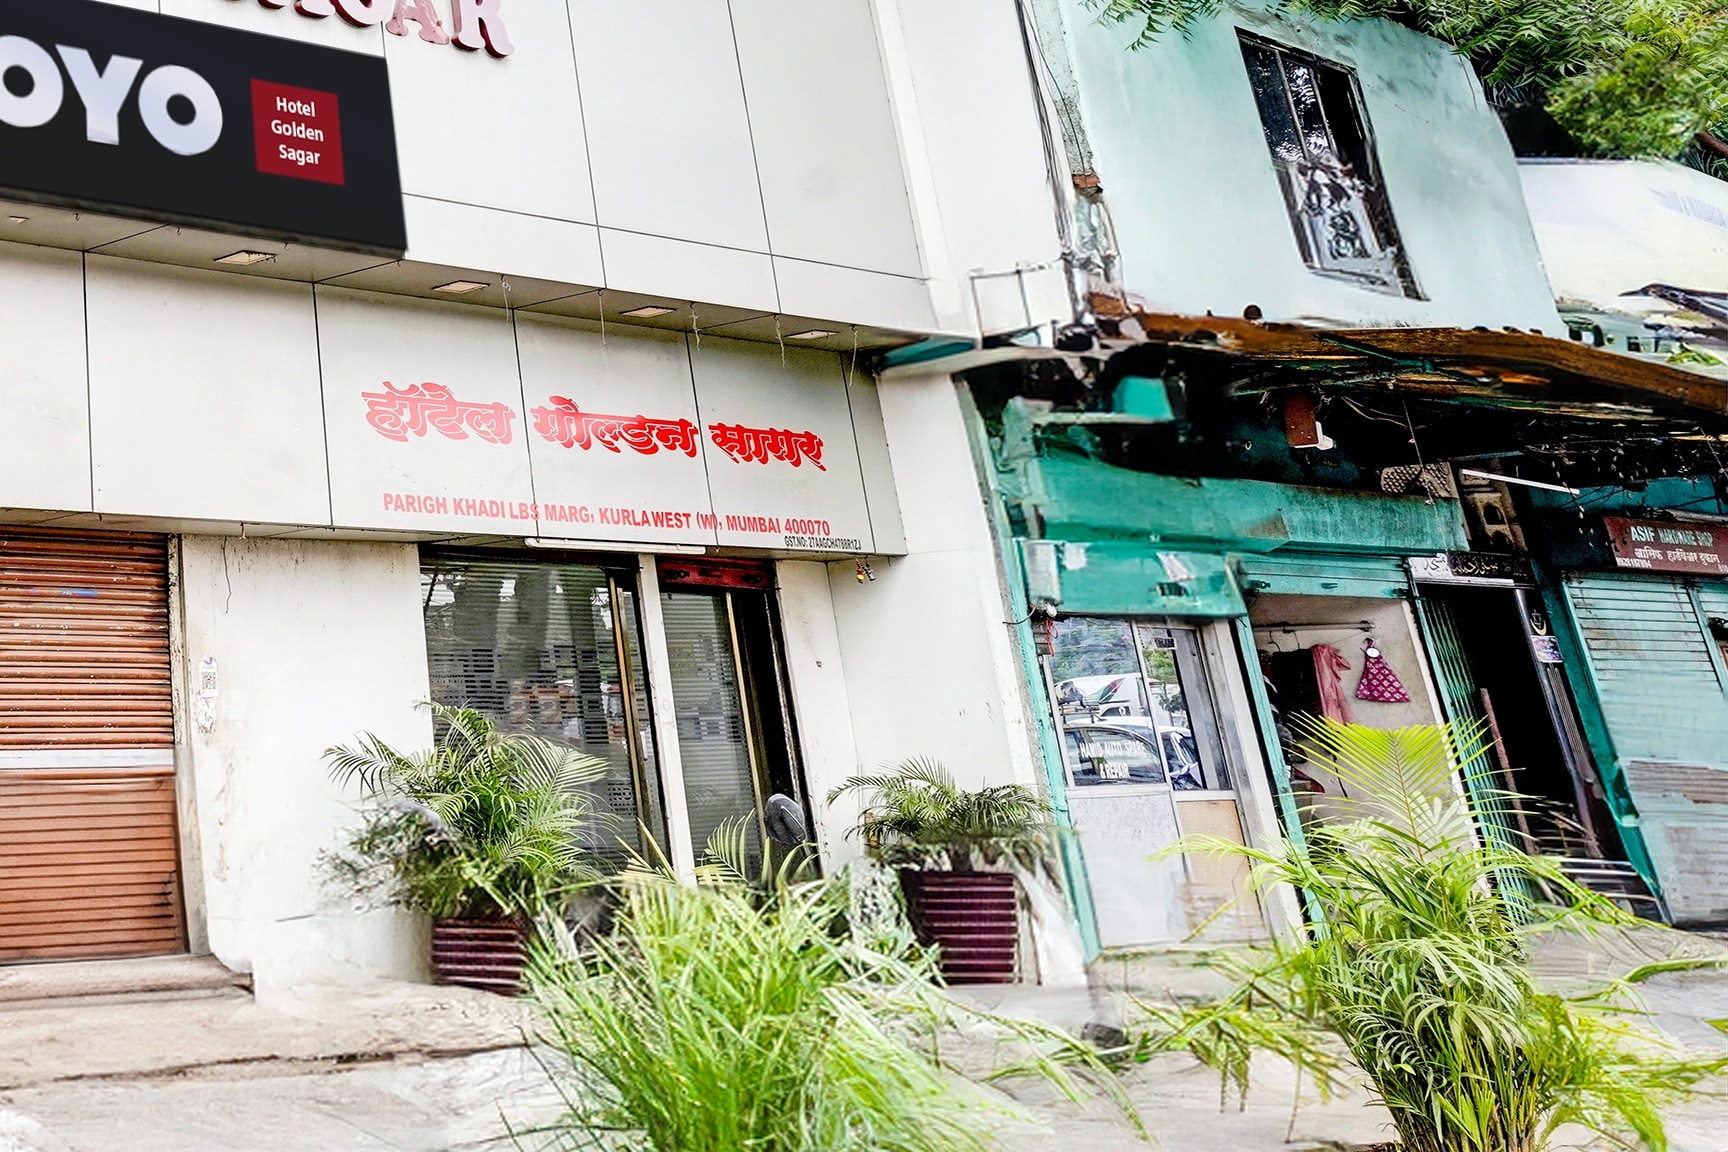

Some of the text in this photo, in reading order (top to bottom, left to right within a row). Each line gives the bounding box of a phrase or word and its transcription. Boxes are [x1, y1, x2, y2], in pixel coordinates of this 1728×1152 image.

[276, 96, 316, 117] Hotel
[271, 119, 324, 142] Golden
[279, 144, 321, 166] Sagar
[530, 395, 699, 459] गोल्डन
[708, 422, 828, 472] सागर
[383, 492, 448, 515] PARIGH
[453, 498, 506, 518] KHADI
[509, 502, 540, 521] LBS
[544, 504, 595, 524] MARG,
[726, 515, 781, 534] MUMBAI
[784, 519, 831, 536] 400070
[1630, 526, 1655, 542] ASIF
[1106, 763, 1131, 779] REPAIR
